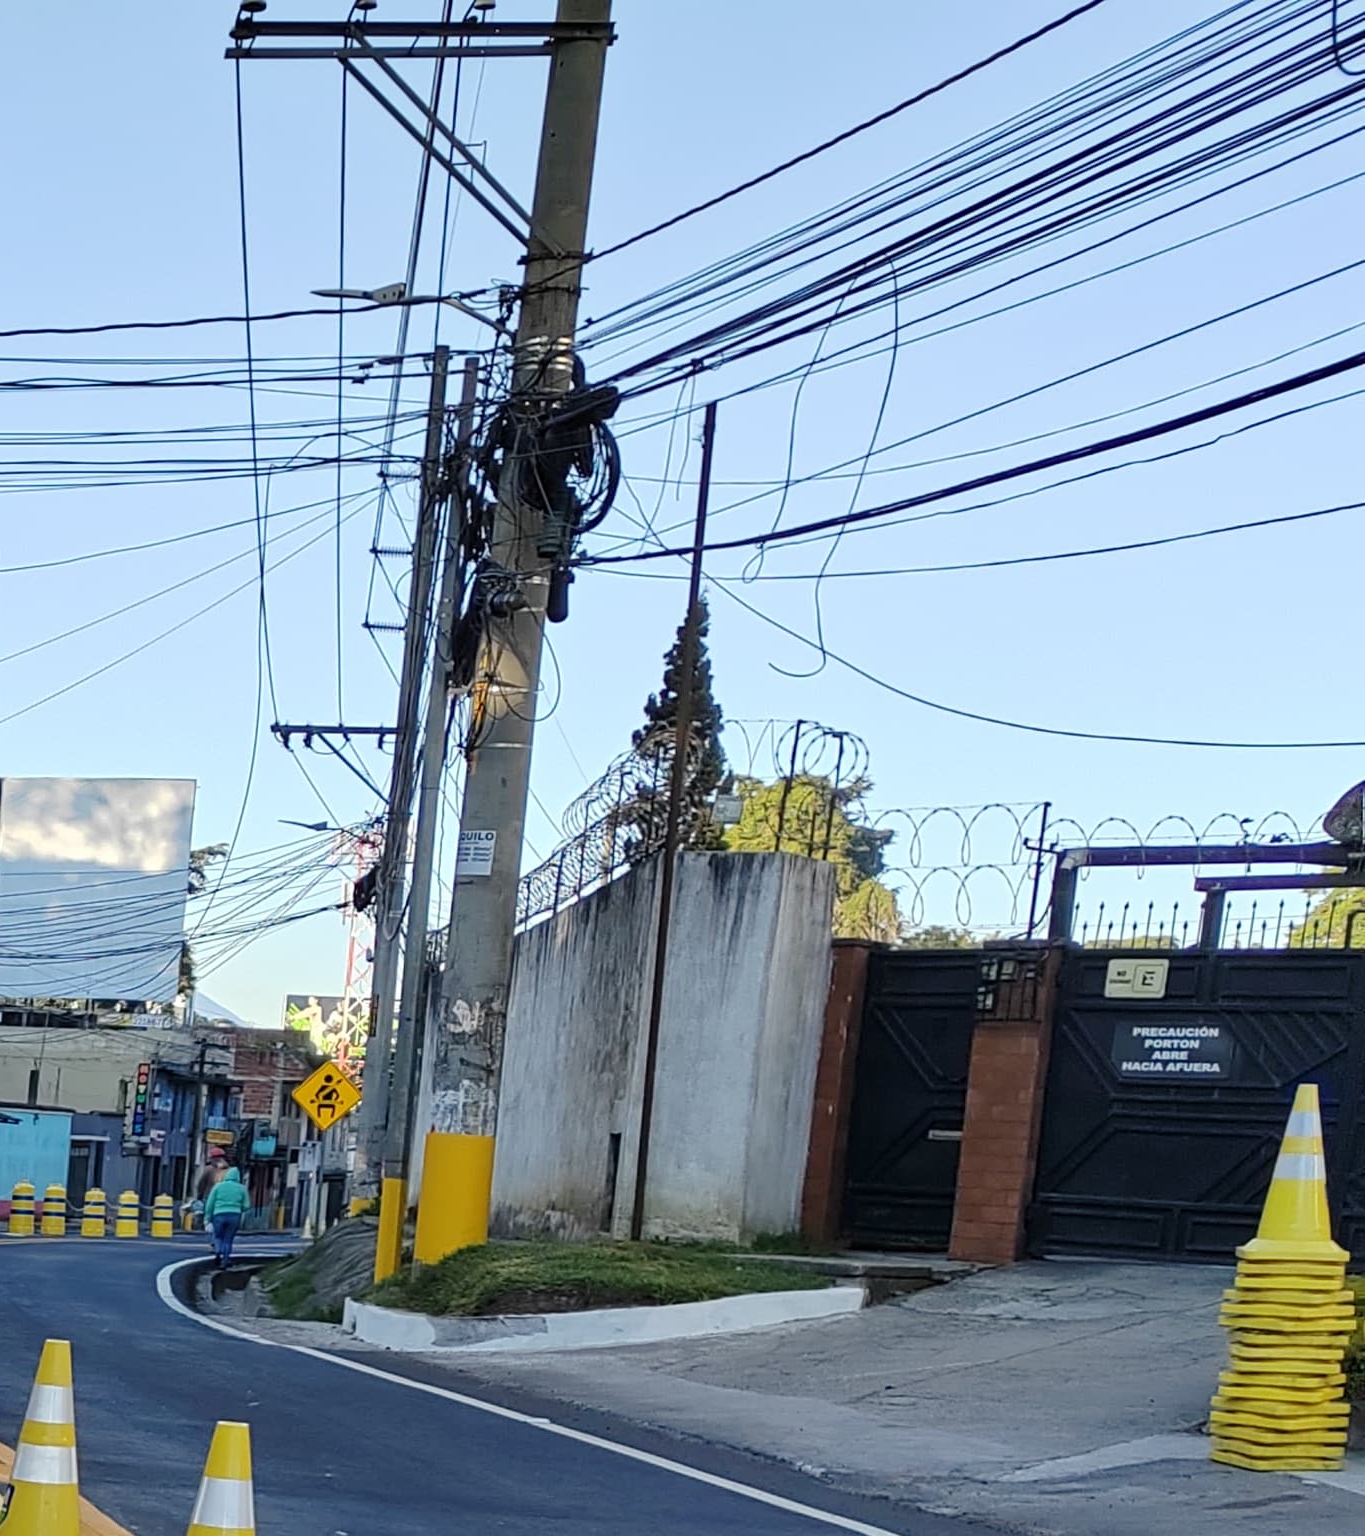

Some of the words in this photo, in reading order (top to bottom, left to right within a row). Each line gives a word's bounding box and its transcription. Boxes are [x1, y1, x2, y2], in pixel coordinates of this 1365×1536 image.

[1132, 1026, 1220, 1038] PRECAUCIÓN
[1144, 1039, 1200, 1049] PORTON
[1151, 1050, 1189, 1060] ABRE
[1121, 1061, 1164, 1072] HACIA
[1165, 1062, 1221, 1073] AFUERA
